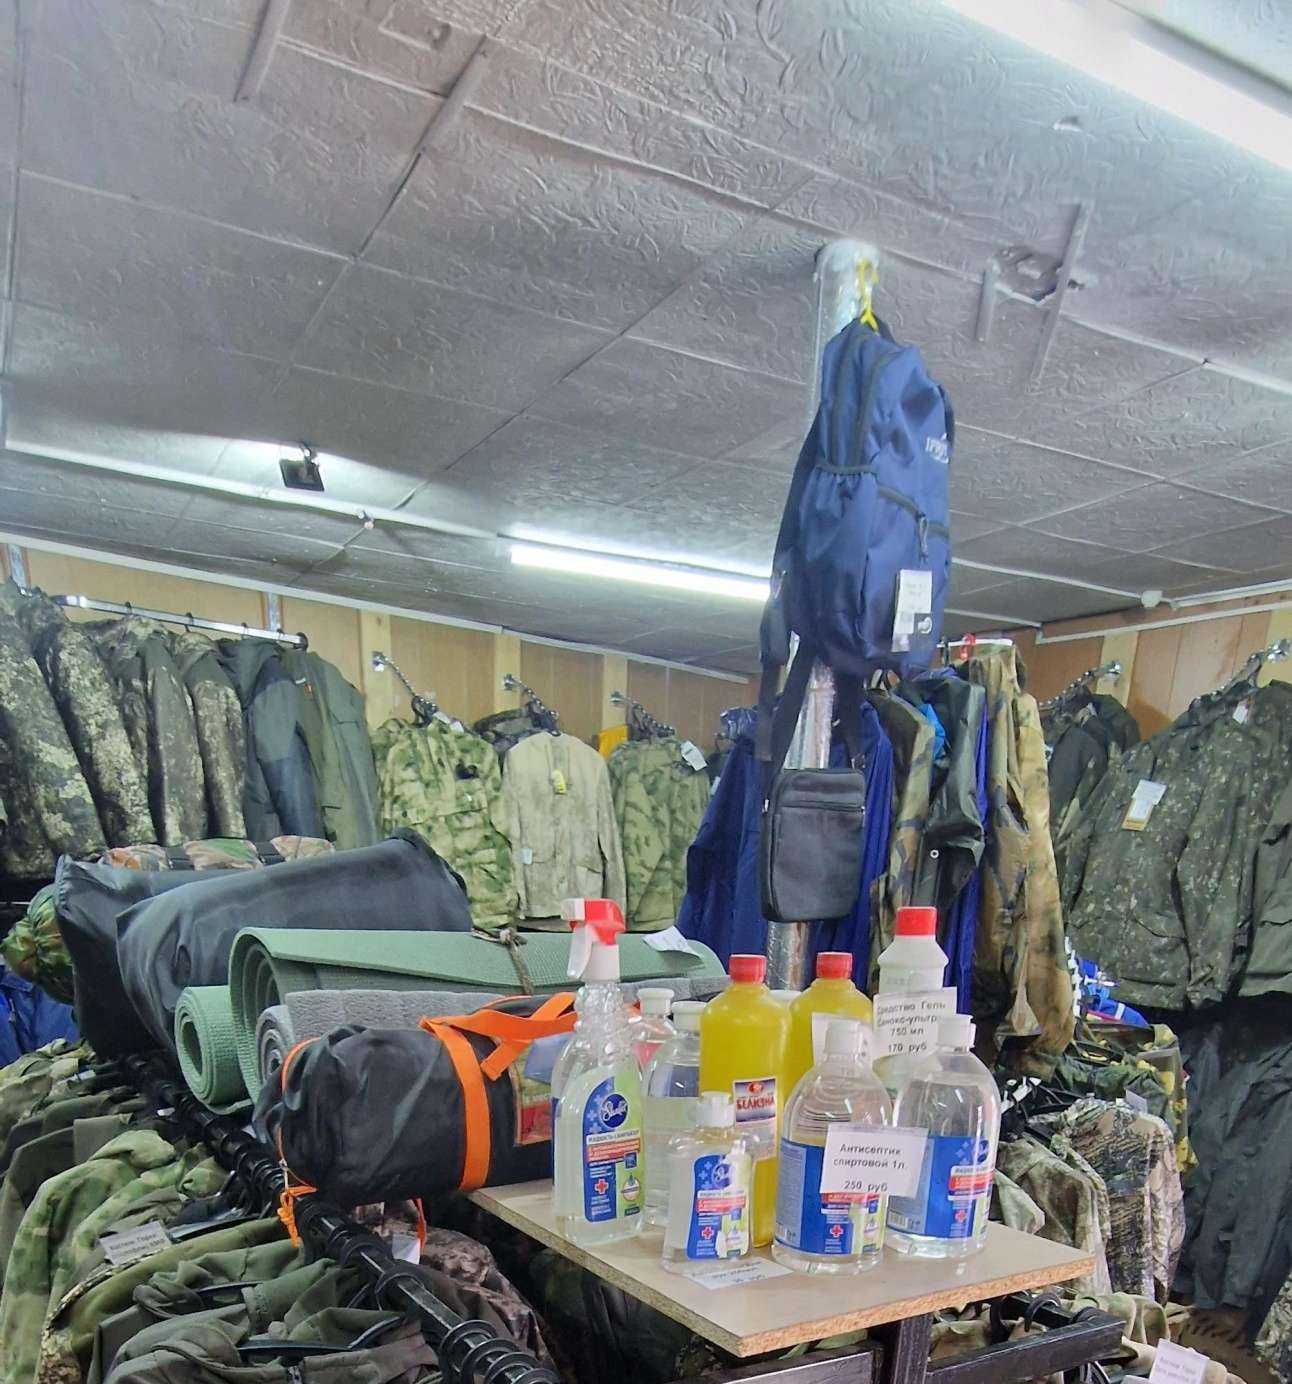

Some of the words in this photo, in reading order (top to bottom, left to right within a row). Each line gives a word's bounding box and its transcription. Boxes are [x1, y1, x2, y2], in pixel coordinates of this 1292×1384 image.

[888, 1043, 903, 1053] 170
[908, 1042, 927, 1054] руб
[840, 1143, 902, 1155] Антисептик
[833, 1158, 888, 1168] спиртовой
[844, 1180, 862, 1190] 250
[867, 1182, 888, 1193] руб
